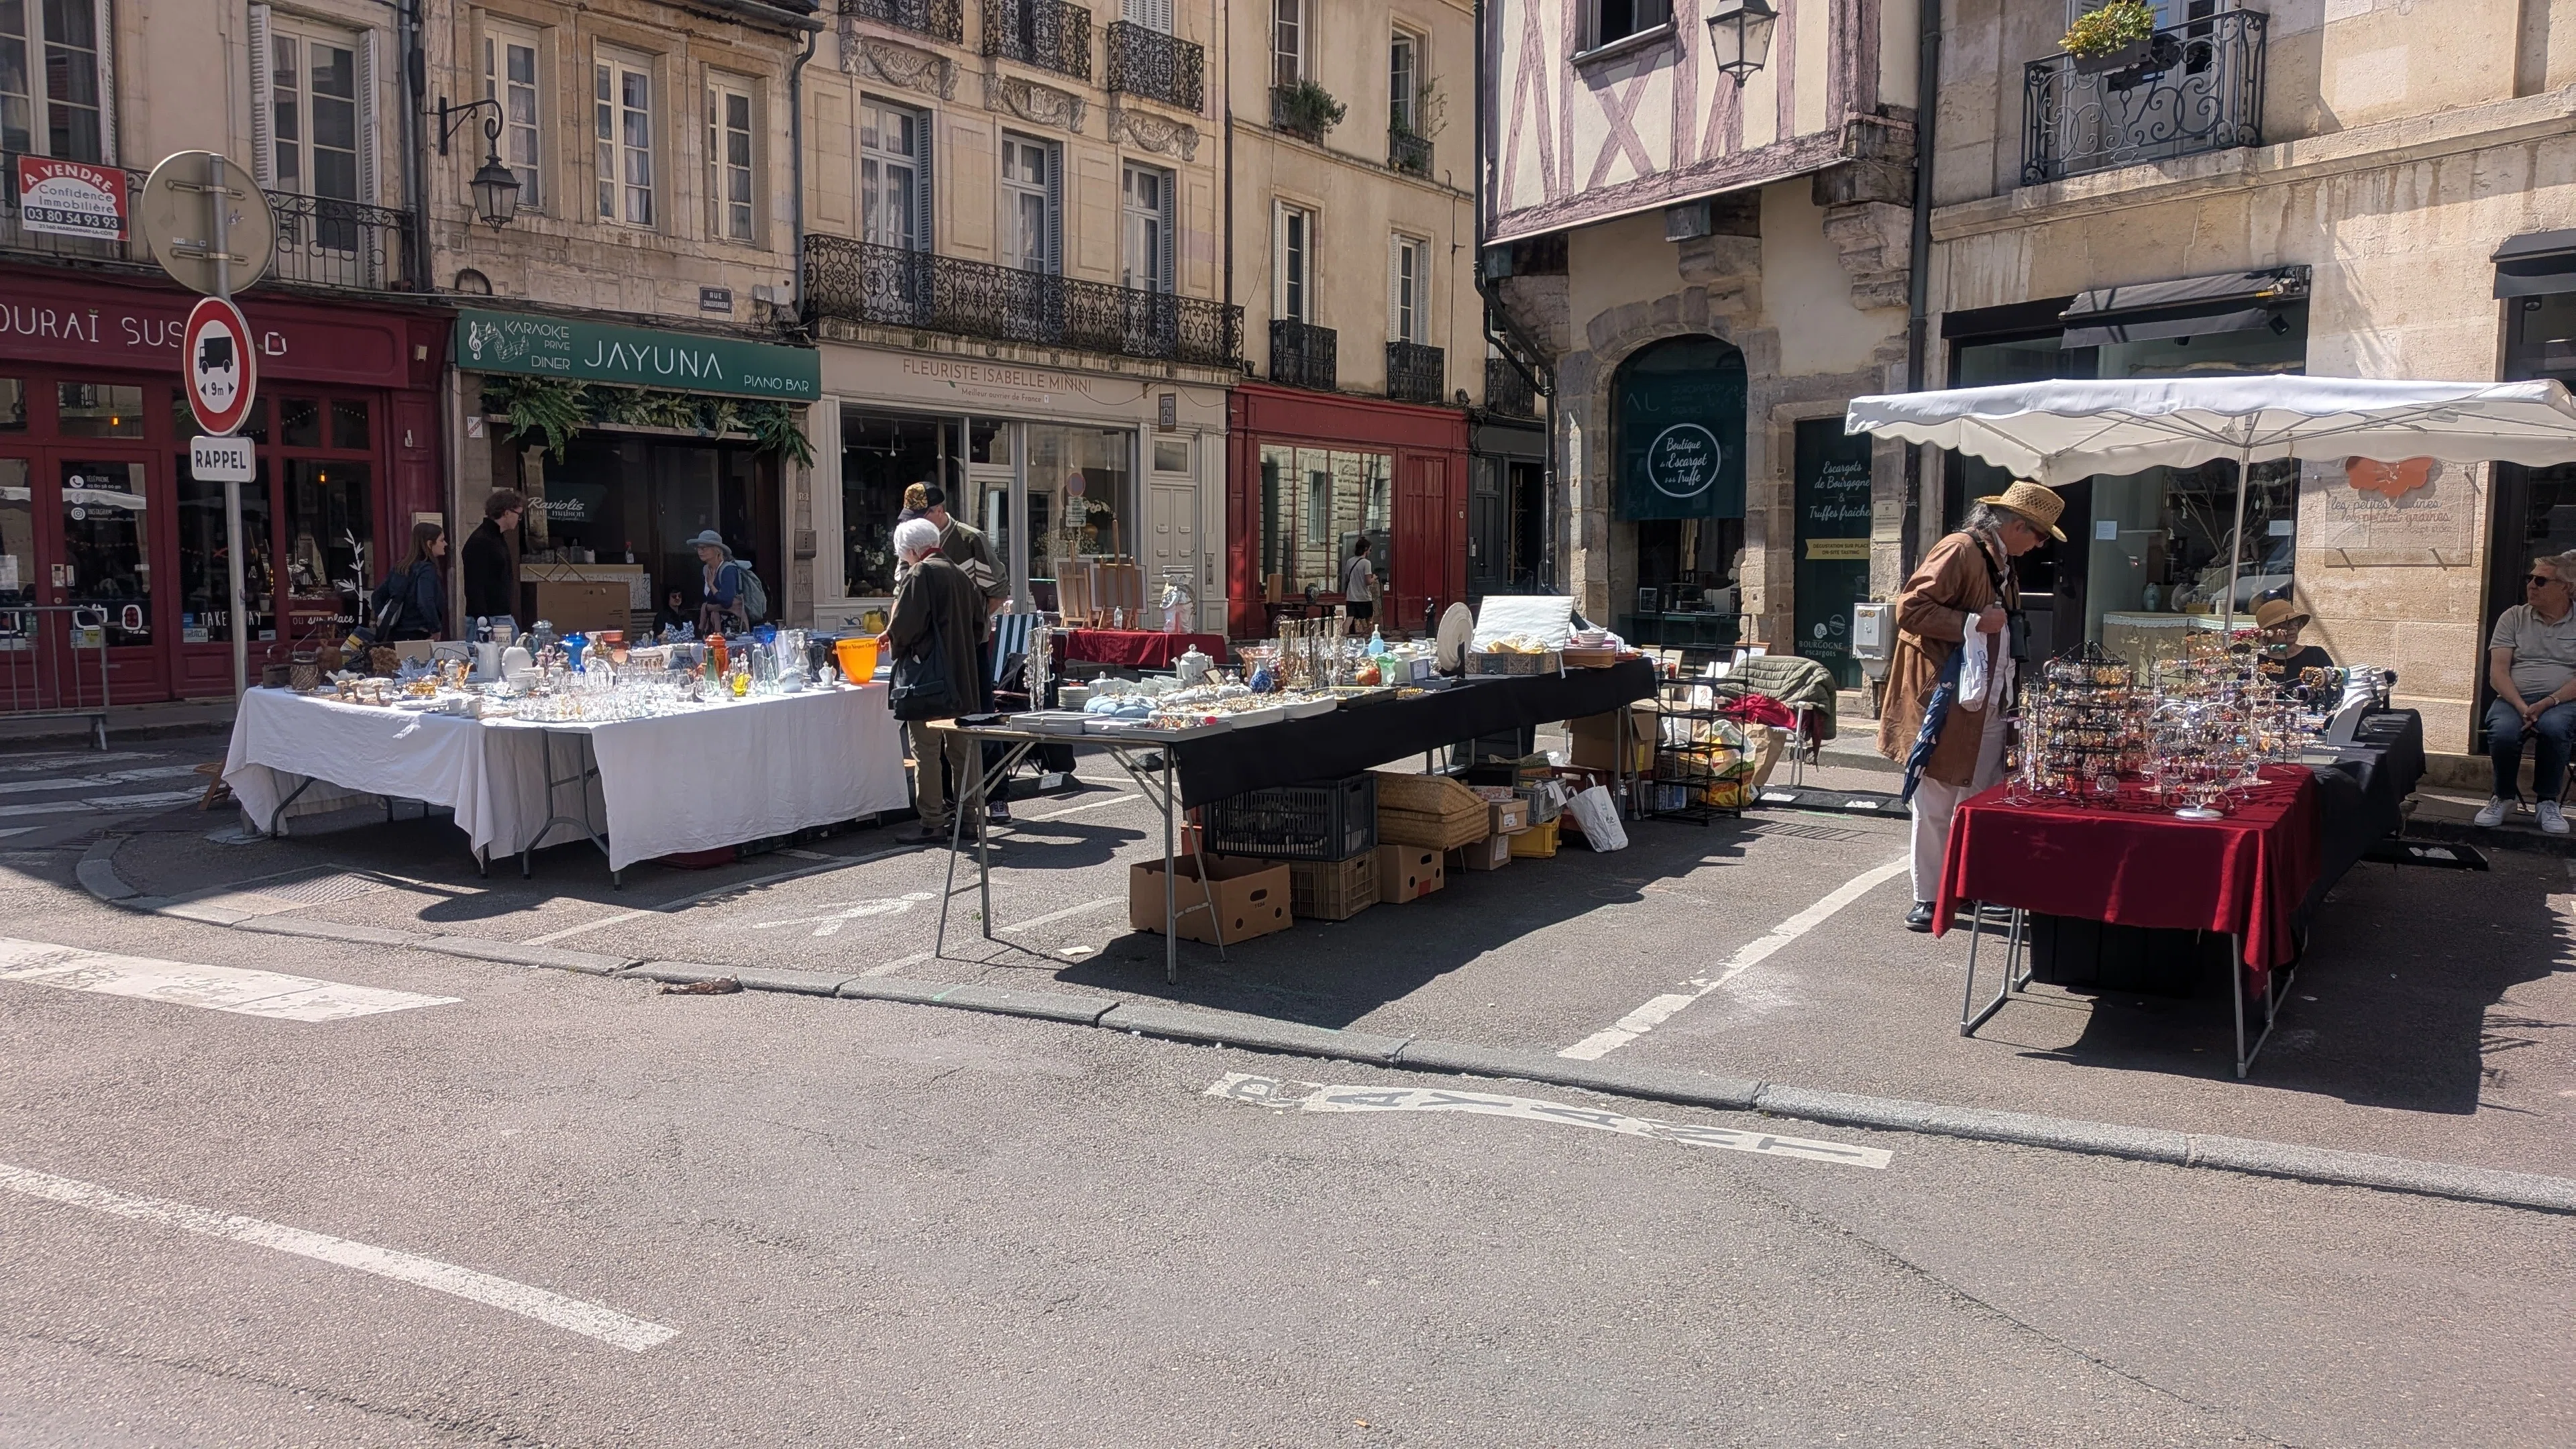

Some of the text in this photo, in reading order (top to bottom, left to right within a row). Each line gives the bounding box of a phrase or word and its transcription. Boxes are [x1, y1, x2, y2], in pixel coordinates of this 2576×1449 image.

[25, 164, 113, 192] A VENDRE
[38, 184, 113, 201] Confidence
[39, 196, 113, 213] Immobilière
[28, 208, 118, 229] 03 80 54 93 93
[709, 292, 722, 300] RUE
[121, 317, 184, 348] SUS
[504, 319, 570, 339] KARAOKE
[544, 340, 571, 351] PRIVE
[531, 356, 571, 371] DINER
[584, 340, 723, 380] JAYUNA
[744, 374, 810, 393] PIANO BAR
[902, 358, 1091, 393] FLEURISTE ISABELLE MININI
[211, 382, 224, 396] 9m
[961, 388, 1042, 403] Meilleur ouvrier de France
[1666, 437, 1702, 453] Boutique
[195, 450, 247, 470] RAPPEL
[1823, 460, 1862, 476] Escargots
[1678, 469, 1702, 486] Truffe
[1815, 476, 1871, 491] de Bourgogne
[528, 496, 585, 511] Raviolis
[1838, 492, 1845, 502] &
[1809, 505, 1838, 521] Truffes
[2331, 496, 2349, 510] les
[2353, 498, 2392, 517] petites
[200, 611, 227, 627] TAKE
[1799, 641, 1843, 650] BOURGOGNE
[1805, 649, 1836, 658] escargots
